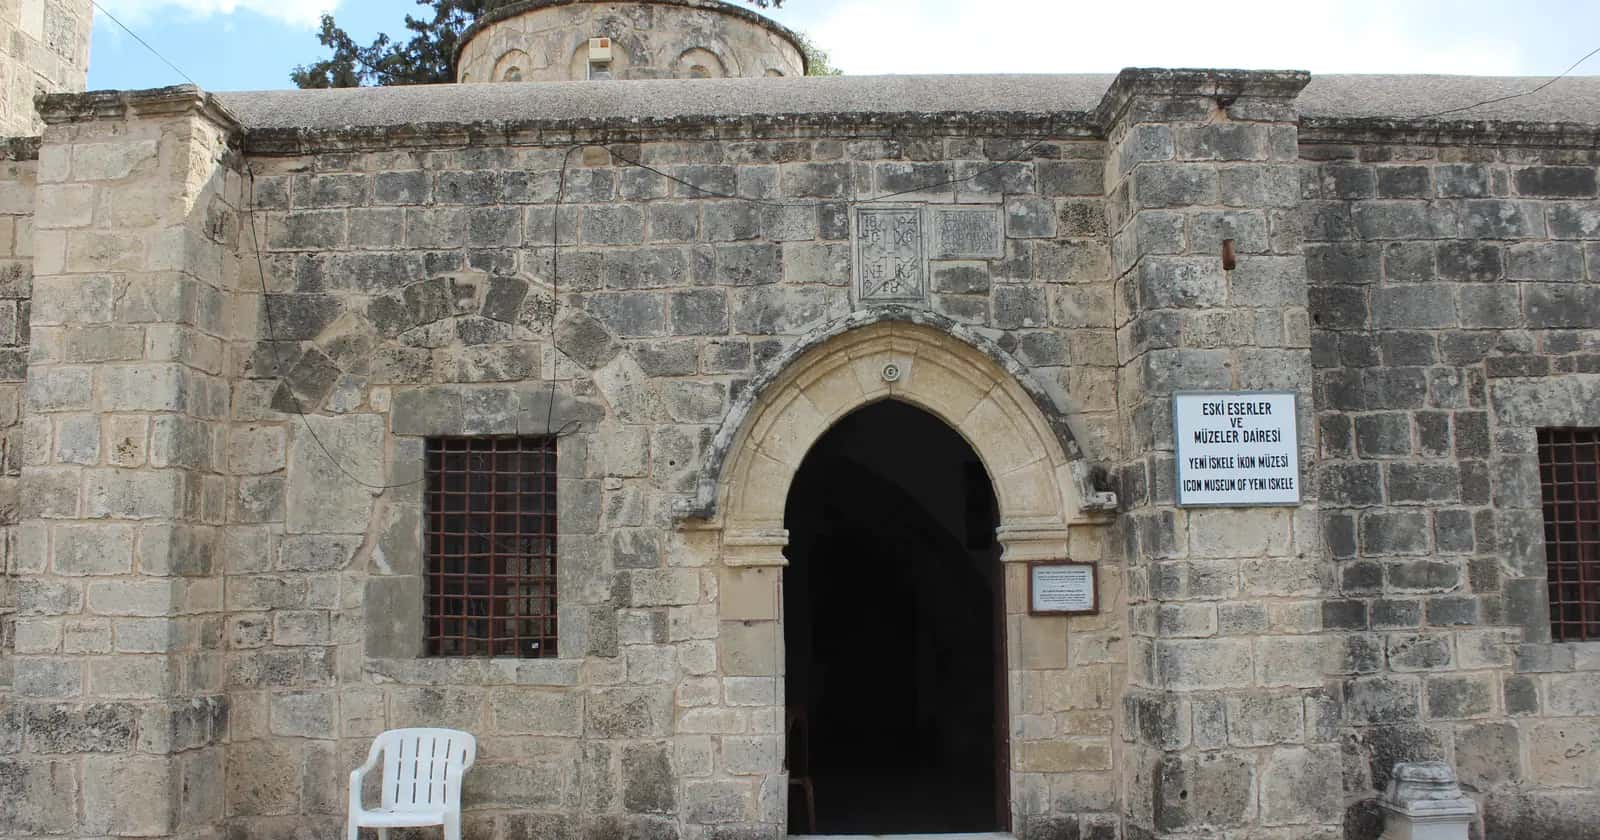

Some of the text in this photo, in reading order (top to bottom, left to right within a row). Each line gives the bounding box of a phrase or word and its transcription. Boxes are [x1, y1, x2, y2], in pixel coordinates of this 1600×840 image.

[1202, 400, 1272, 415] ESKİ ESERLER
[1230, 418, 1243, 428] VE
[1194, 428, 1280, 443] MÜZELER DAİRESİ
[1237, 454, 1255, 468] İKON
[1259, 454, 1288, 468] MÜZESİ
[1184, 478, 1293, 491] ICON MUSEUM OF YENI ISKELE
